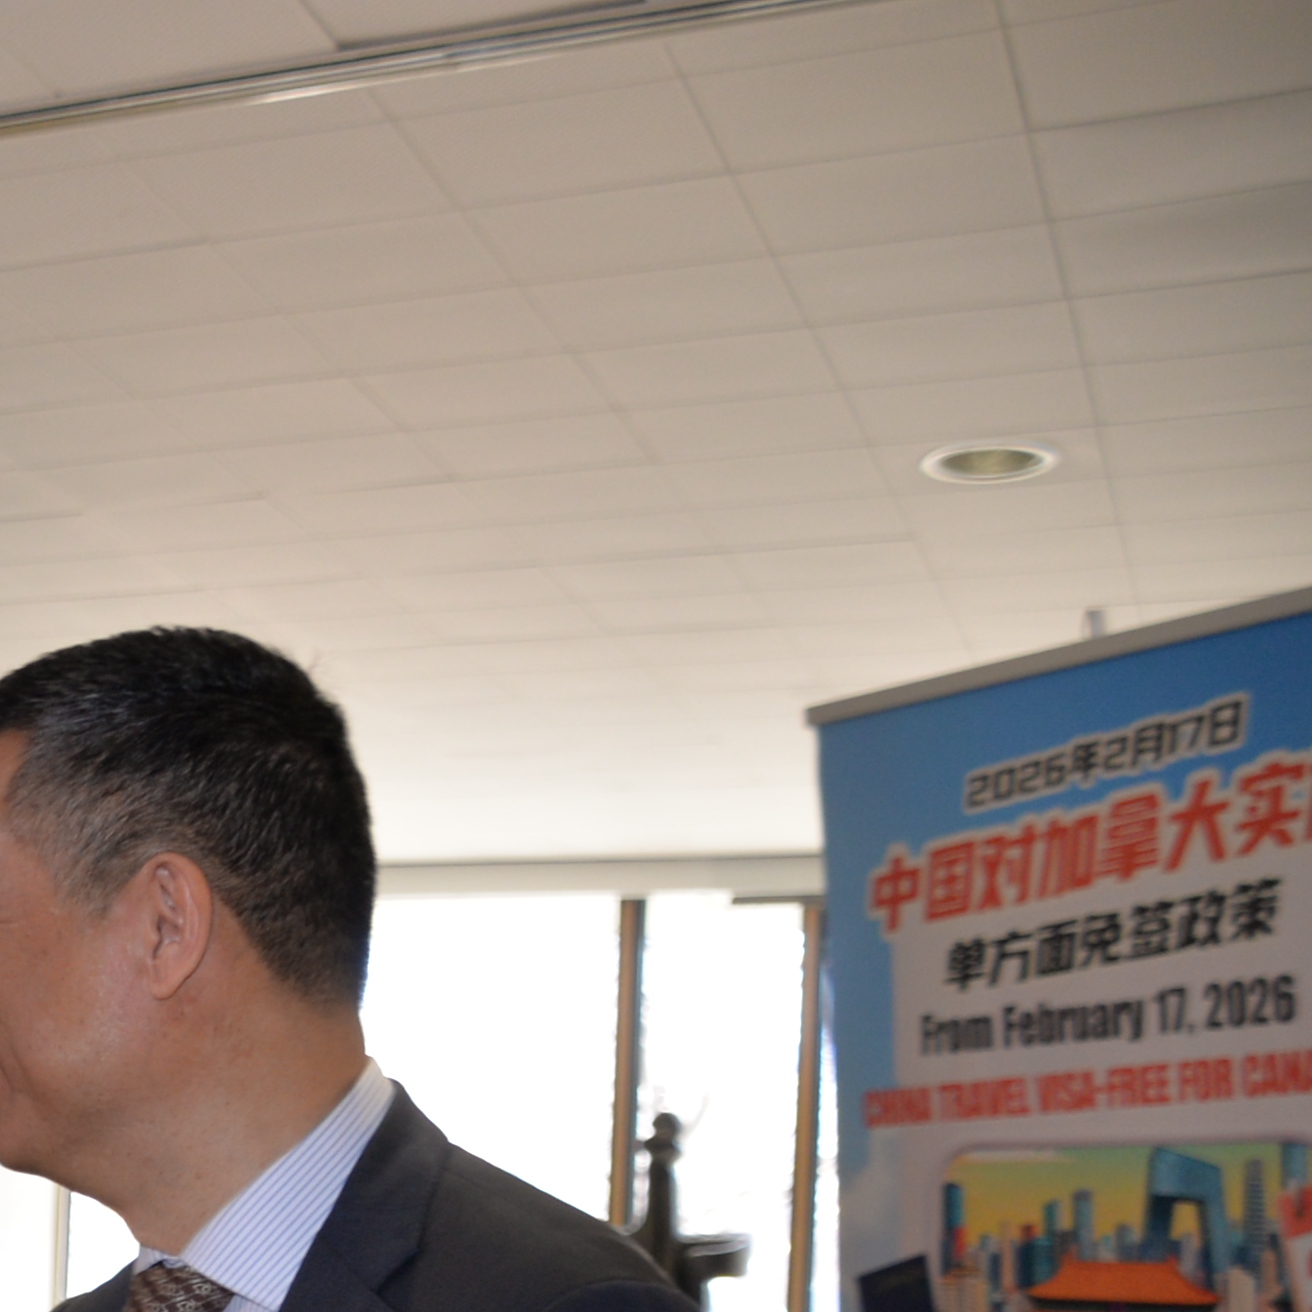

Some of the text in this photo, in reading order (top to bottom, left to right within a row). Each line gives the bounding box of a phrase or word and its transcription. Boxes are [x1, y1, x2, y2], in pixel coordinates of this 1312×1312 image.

[964, 699, 1244, 810] 2026年2月17日
[870, 760, 1312, 933] 中国对加拿大实
[944, 876, 1283, 992] 单方面免签政策
[920, 973, 1297, 1056] From February 17, 2026
[1178, 1056, 1234, 1104] FOR
